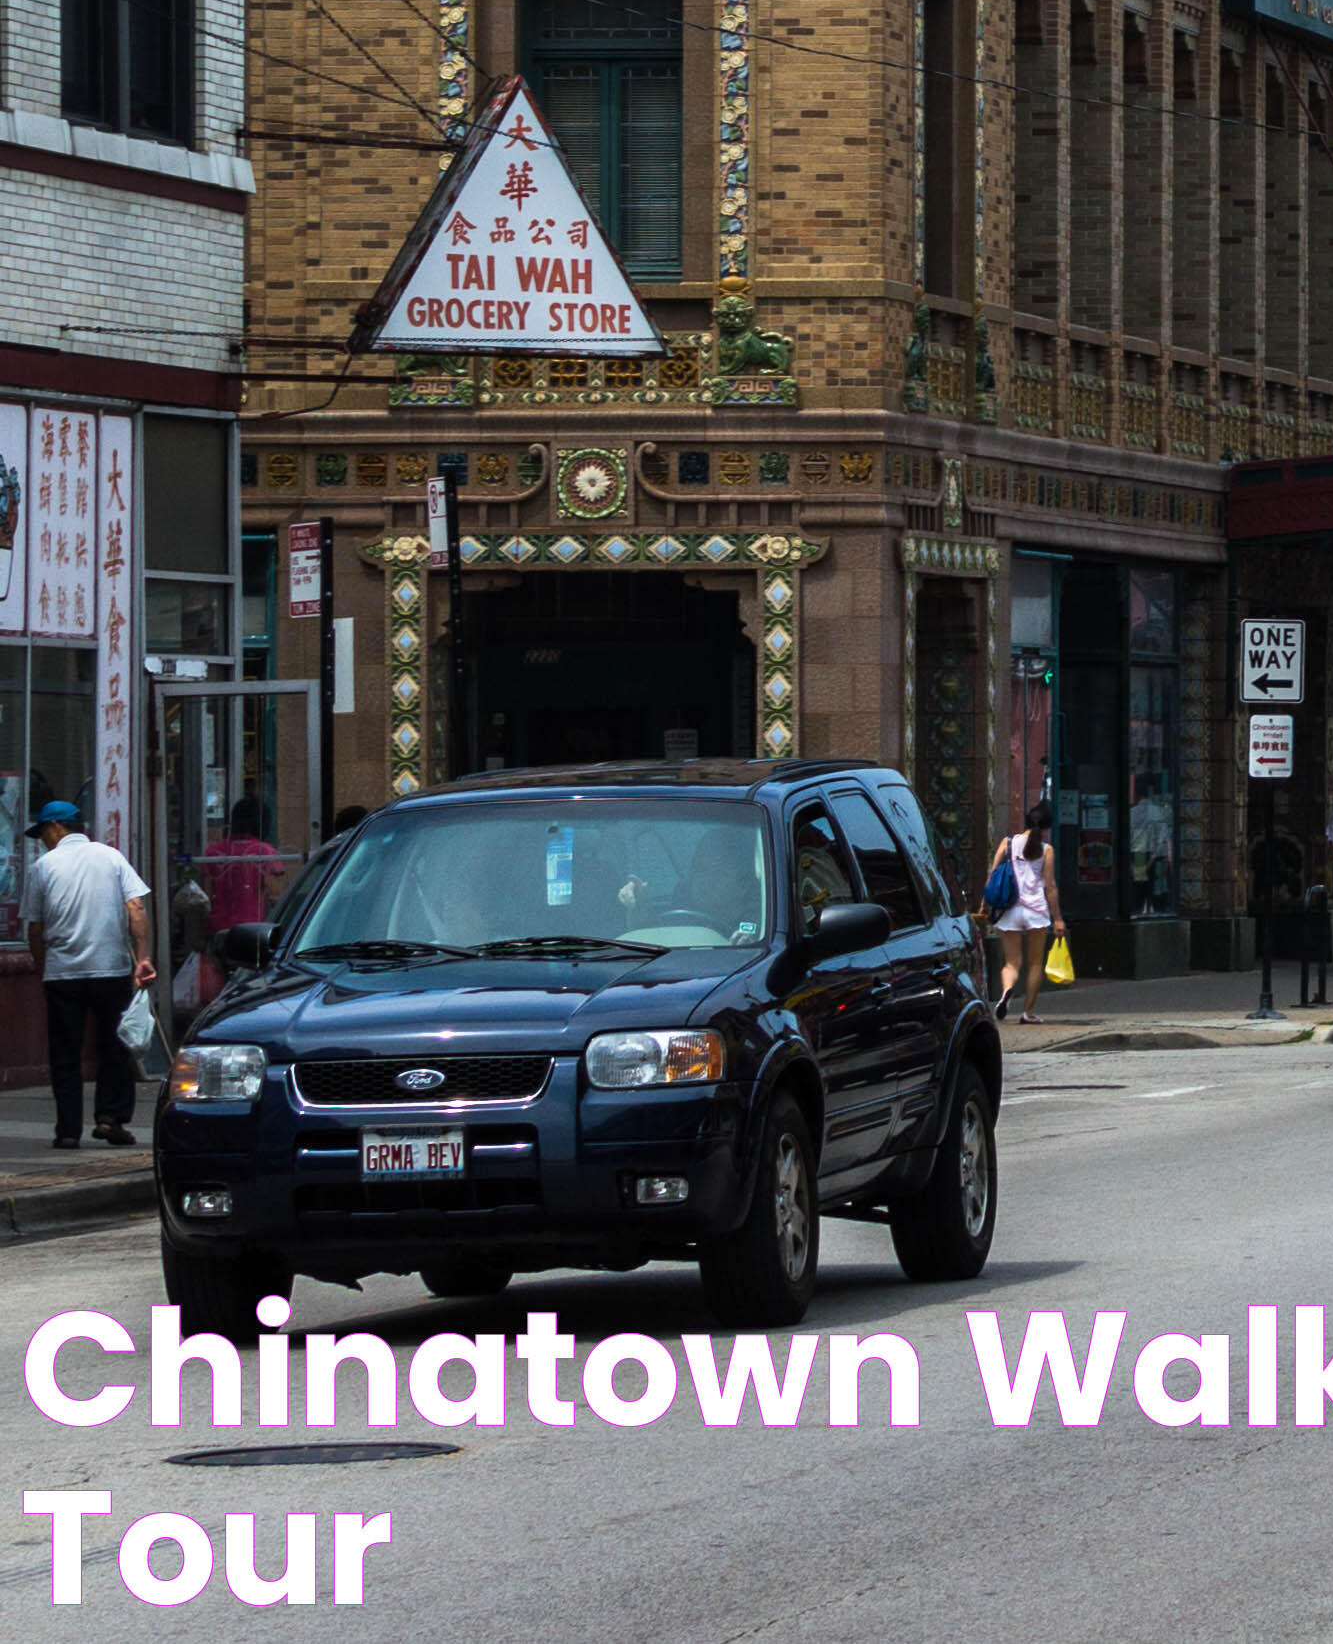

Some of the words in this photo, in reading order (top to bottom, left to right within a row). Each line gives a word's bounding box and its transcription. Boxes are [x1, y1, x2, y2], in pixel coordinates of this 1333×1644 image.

[499, 113, 541, 213] 大華
[444, 211, 590, 250] 食品公司
[445, 253, 496, 292] TAI
[514, 256, 593, 295] WAH
[405, 296, 531, 331] GROCERY
[548, 302, 632, 335] STORE
[1249, 627, 1296, 648] ONE
[1248, 649, 1297, 670] WAY
[405, 1072, 434, 1086] Ford
[366, 1143, 415, 1172] GRMA
[426, 1141, 461, 1170] BEV
